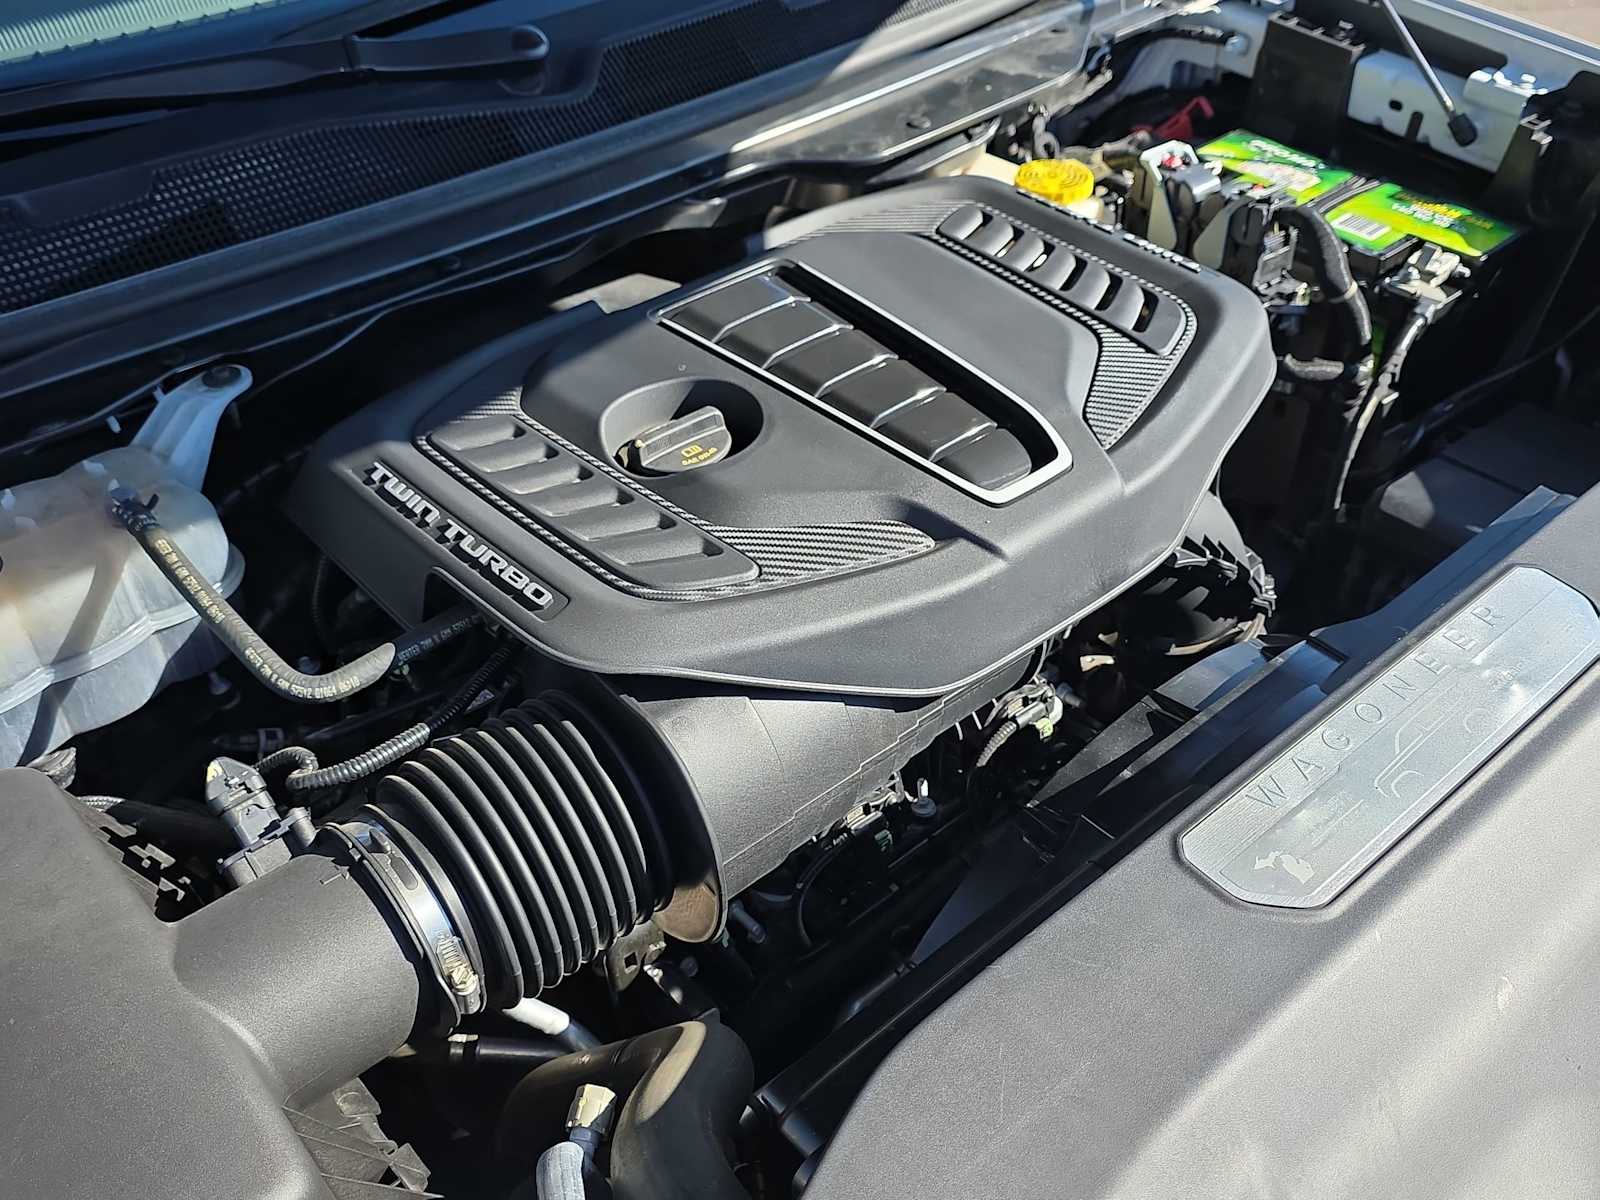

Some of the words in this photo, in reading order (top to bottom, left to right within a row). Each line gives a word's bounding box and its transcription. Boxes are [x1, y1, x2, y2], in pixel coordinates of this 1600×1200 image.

[369, 461, 441, 527] TWIN
[443, 518, 554, 610] TURBO
[1245, 605, 1505, 808] WAGONEER
